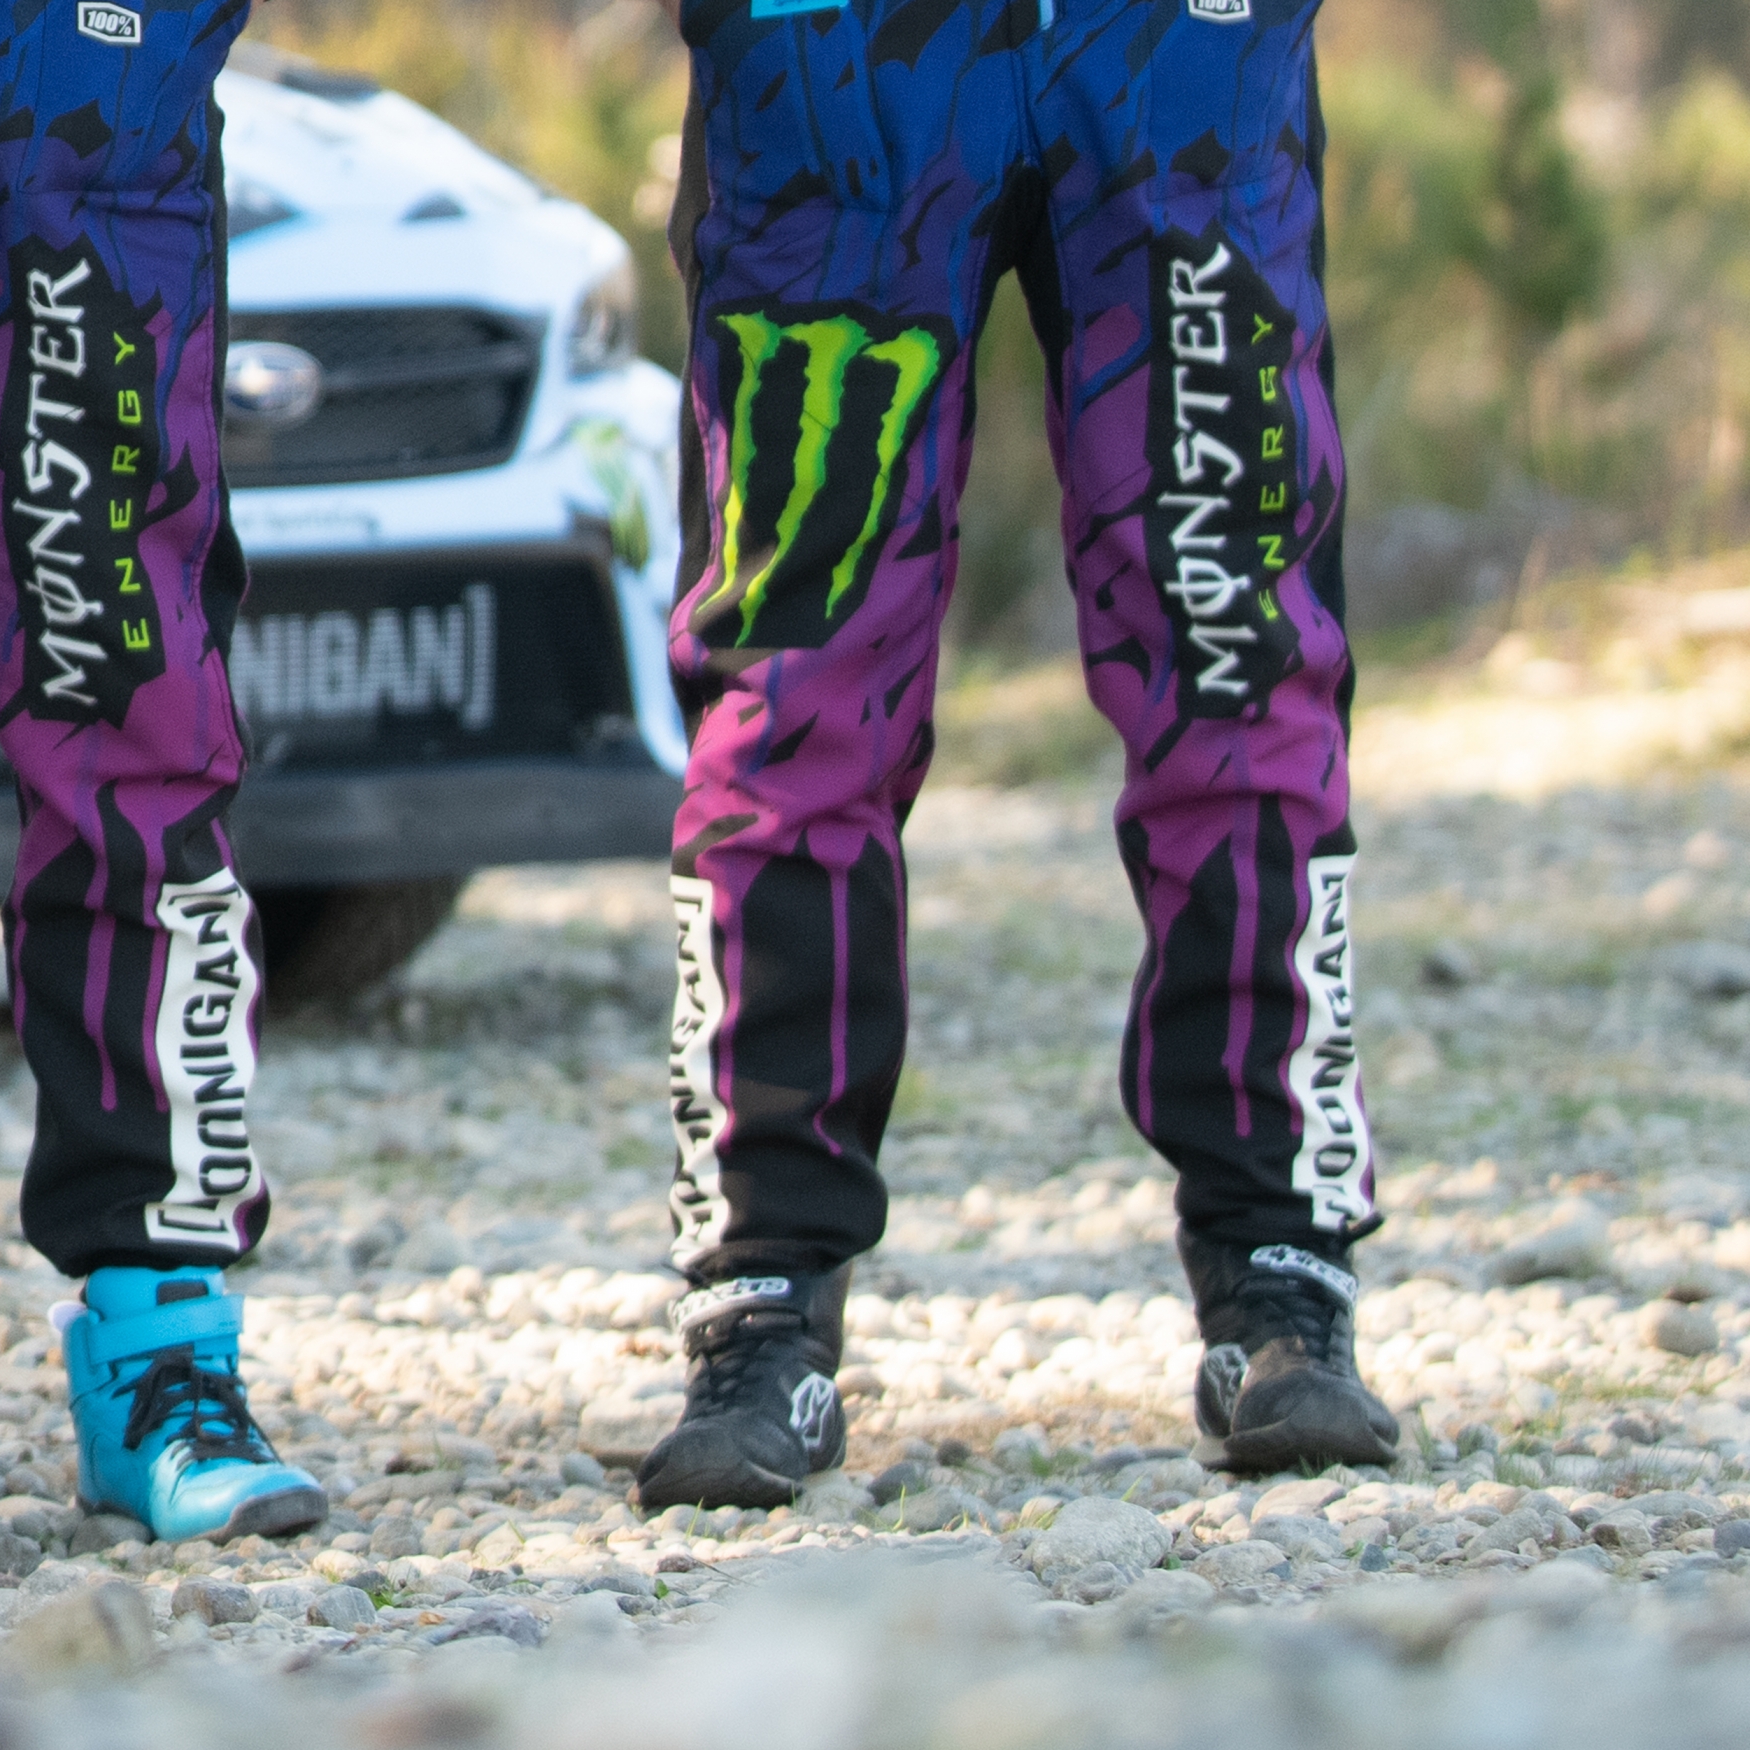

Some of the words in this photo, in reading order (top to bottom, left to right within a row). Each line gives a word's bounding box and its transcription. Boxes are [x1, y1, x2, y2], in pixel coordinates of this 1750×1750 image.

[87, 10, 133, 36] 100%
[109, 330, 151, 650] ENERGY
[1251, 313, 1287, 621] ENERGY
